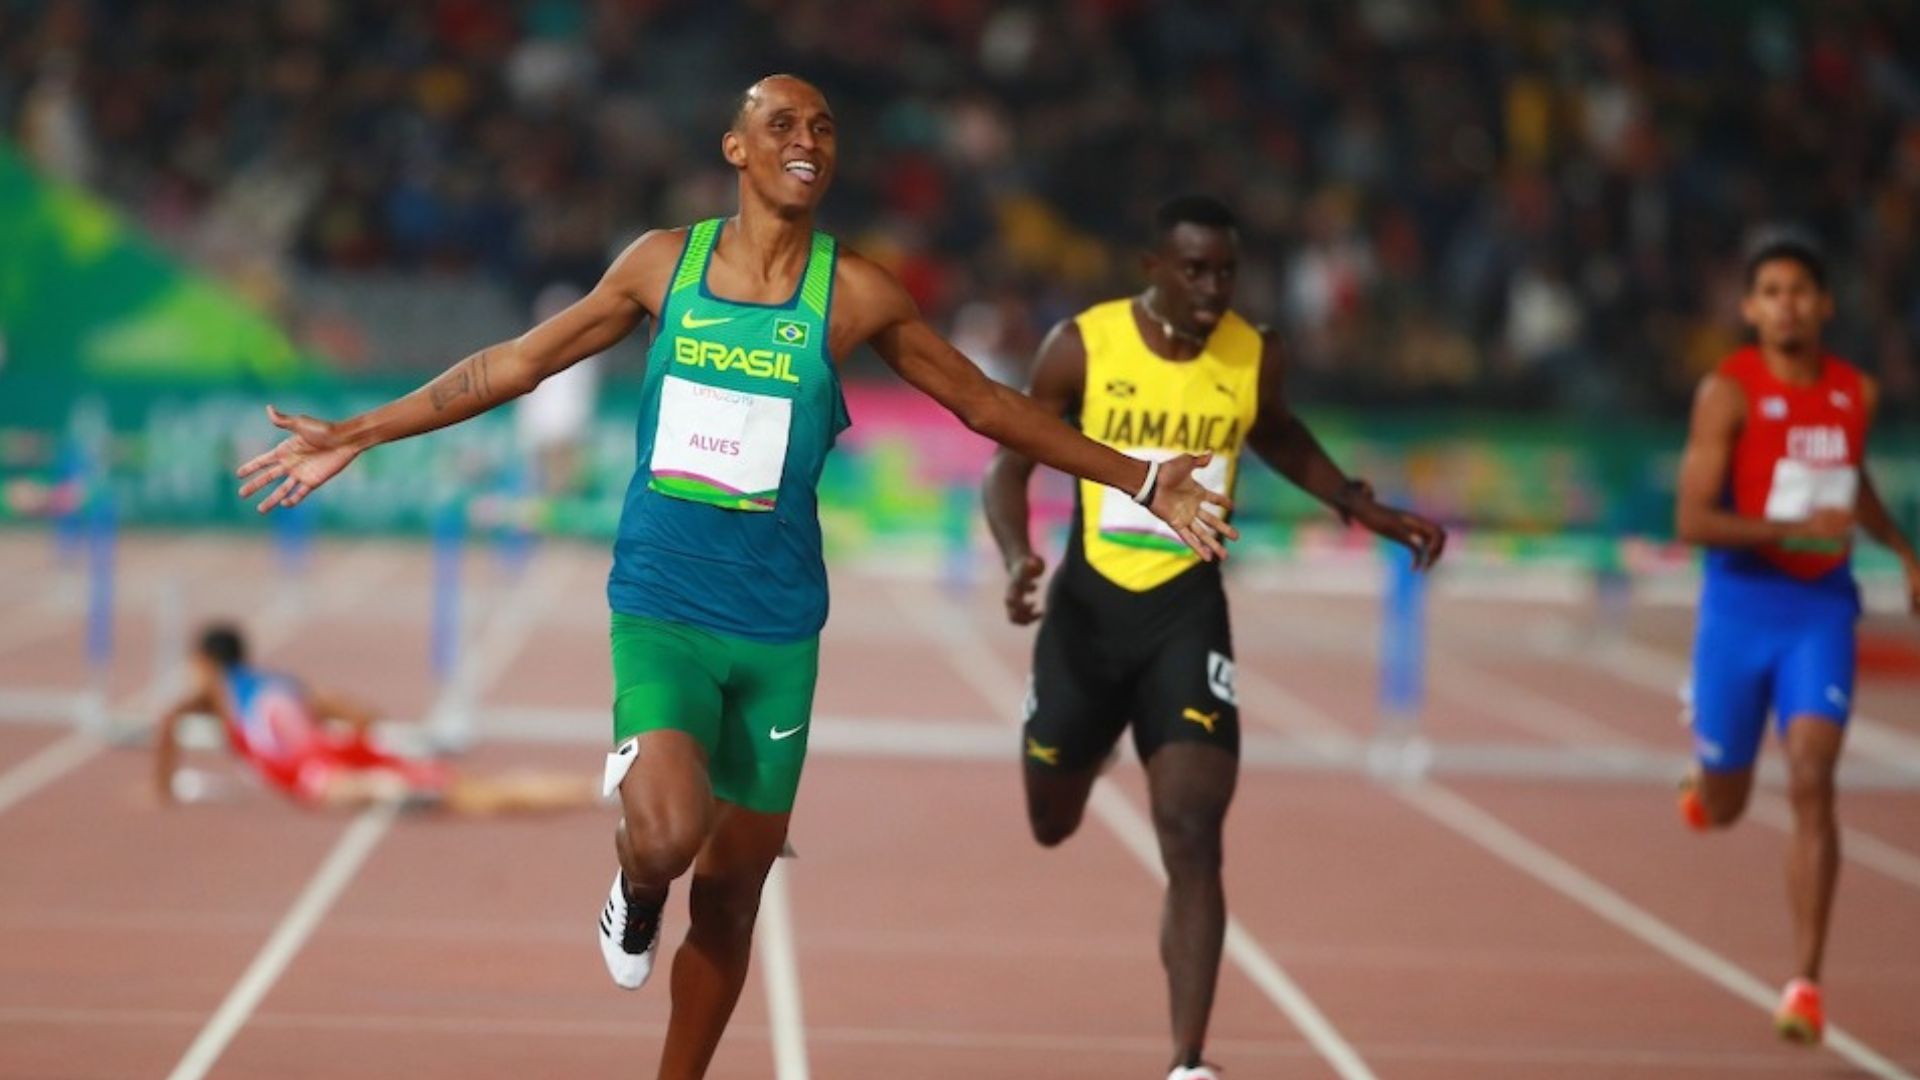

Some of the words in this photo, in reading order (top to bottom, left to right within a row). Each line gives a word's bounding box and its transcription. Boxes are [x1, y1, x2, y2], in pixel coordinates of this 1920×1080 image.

[675, 336, 799, 383] BRASIL
[689, 434, 740, 456] ALVES
[1102, 407, 1239, 451] JAMAICA
